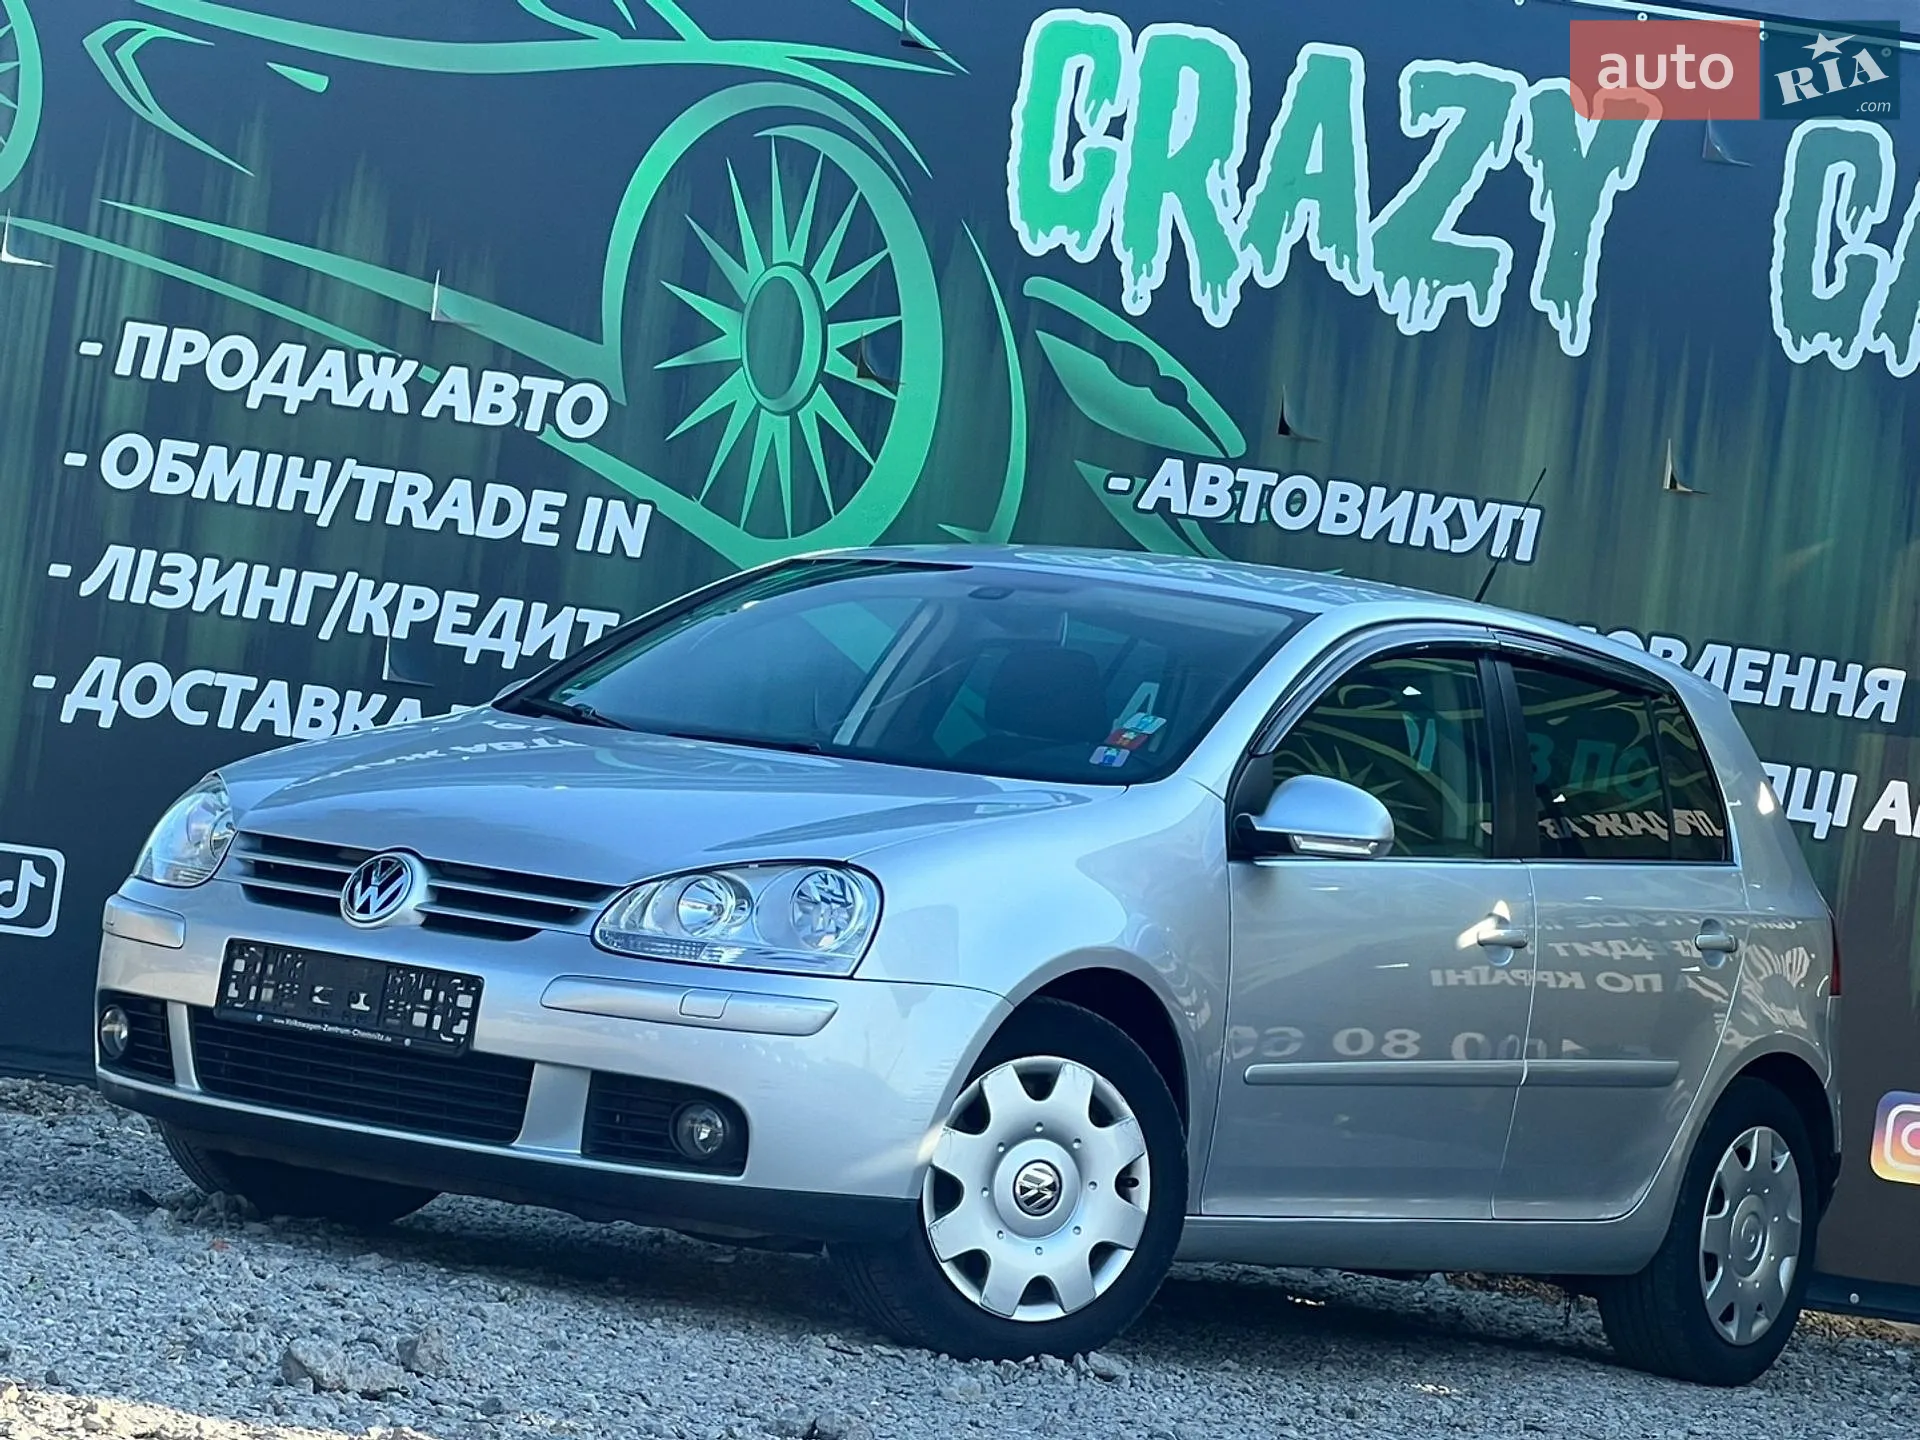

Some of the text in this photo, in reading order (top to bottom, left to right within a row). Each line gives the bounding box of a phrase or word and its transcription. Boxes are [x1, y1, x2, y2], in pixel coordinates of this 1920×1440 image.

[1007, 8, 1663, 356] CRAZY
[113, 320, 420, 414] ПРОДАЖ
[421, 365, 610, 439] АВТО
[100, 433, 568, 549] ОБМІН/TRADE
[576, 496, 653, 559] IN
[1137, 457, 1543, 563] АВТОВИКУП
[79, 544, 621, 669] ЛІЗИНГ/КРЕДИТ
[1862, 780, 1920, 838] А
